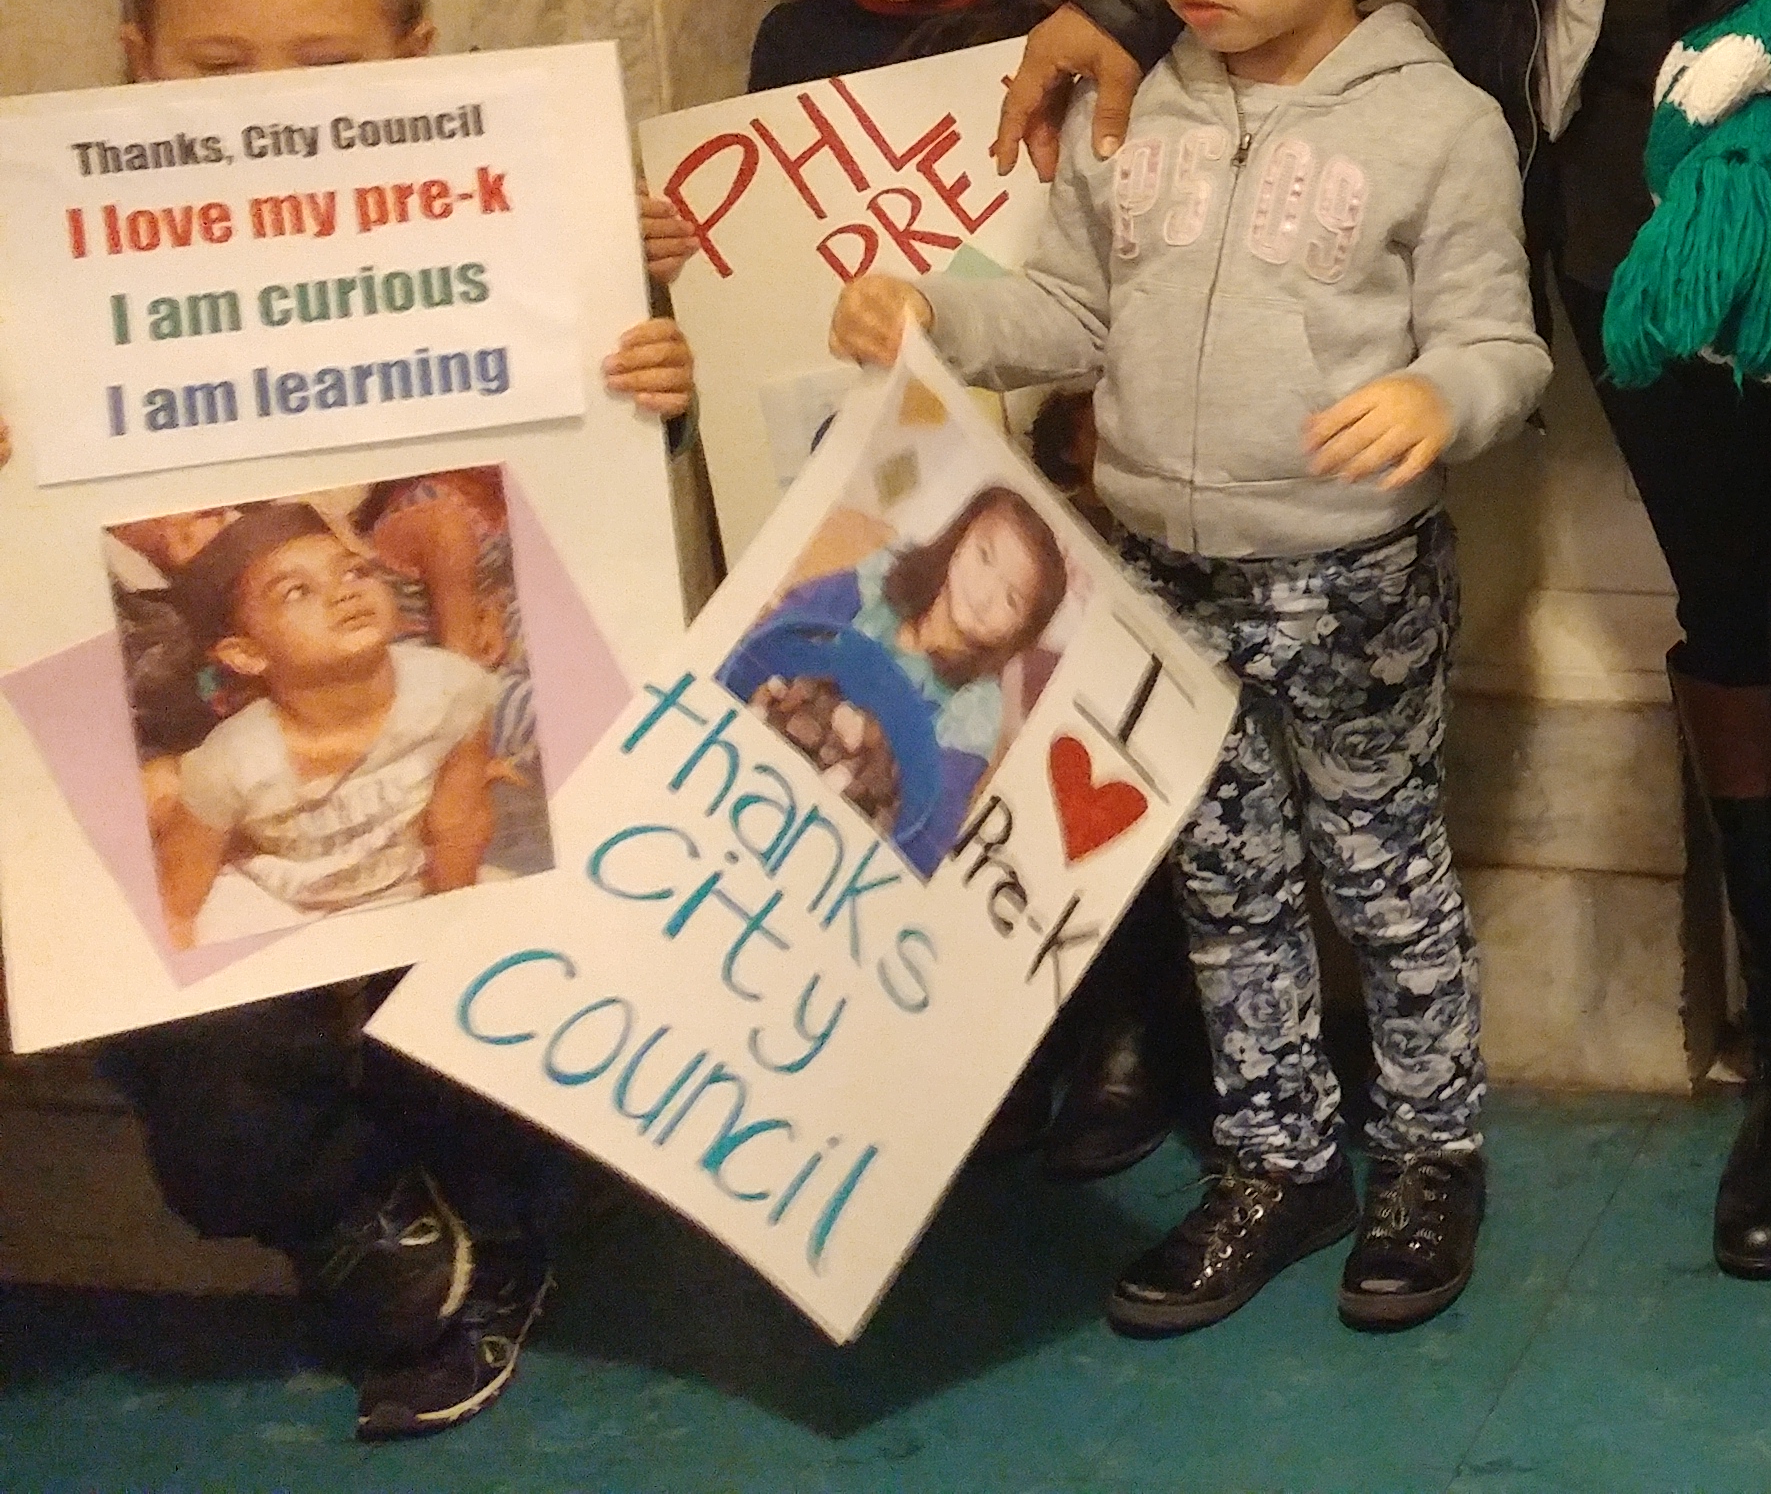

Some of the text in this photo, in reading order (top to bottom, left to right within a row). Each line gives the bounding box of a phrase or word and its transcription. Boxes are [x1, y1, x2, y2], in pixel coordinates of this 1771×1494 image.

[71, 103, 486, 177] Thanks, City Council
[664, 76, 957, 279] PHL
[66, 166, 513, 259] I love my pre-k
[109, 260, 490, 345] I am curious
[107, 346, 510, 438] I am learning
[1074, 610, 1197, 804] I
[621, 671, 937, 1014] thanks
